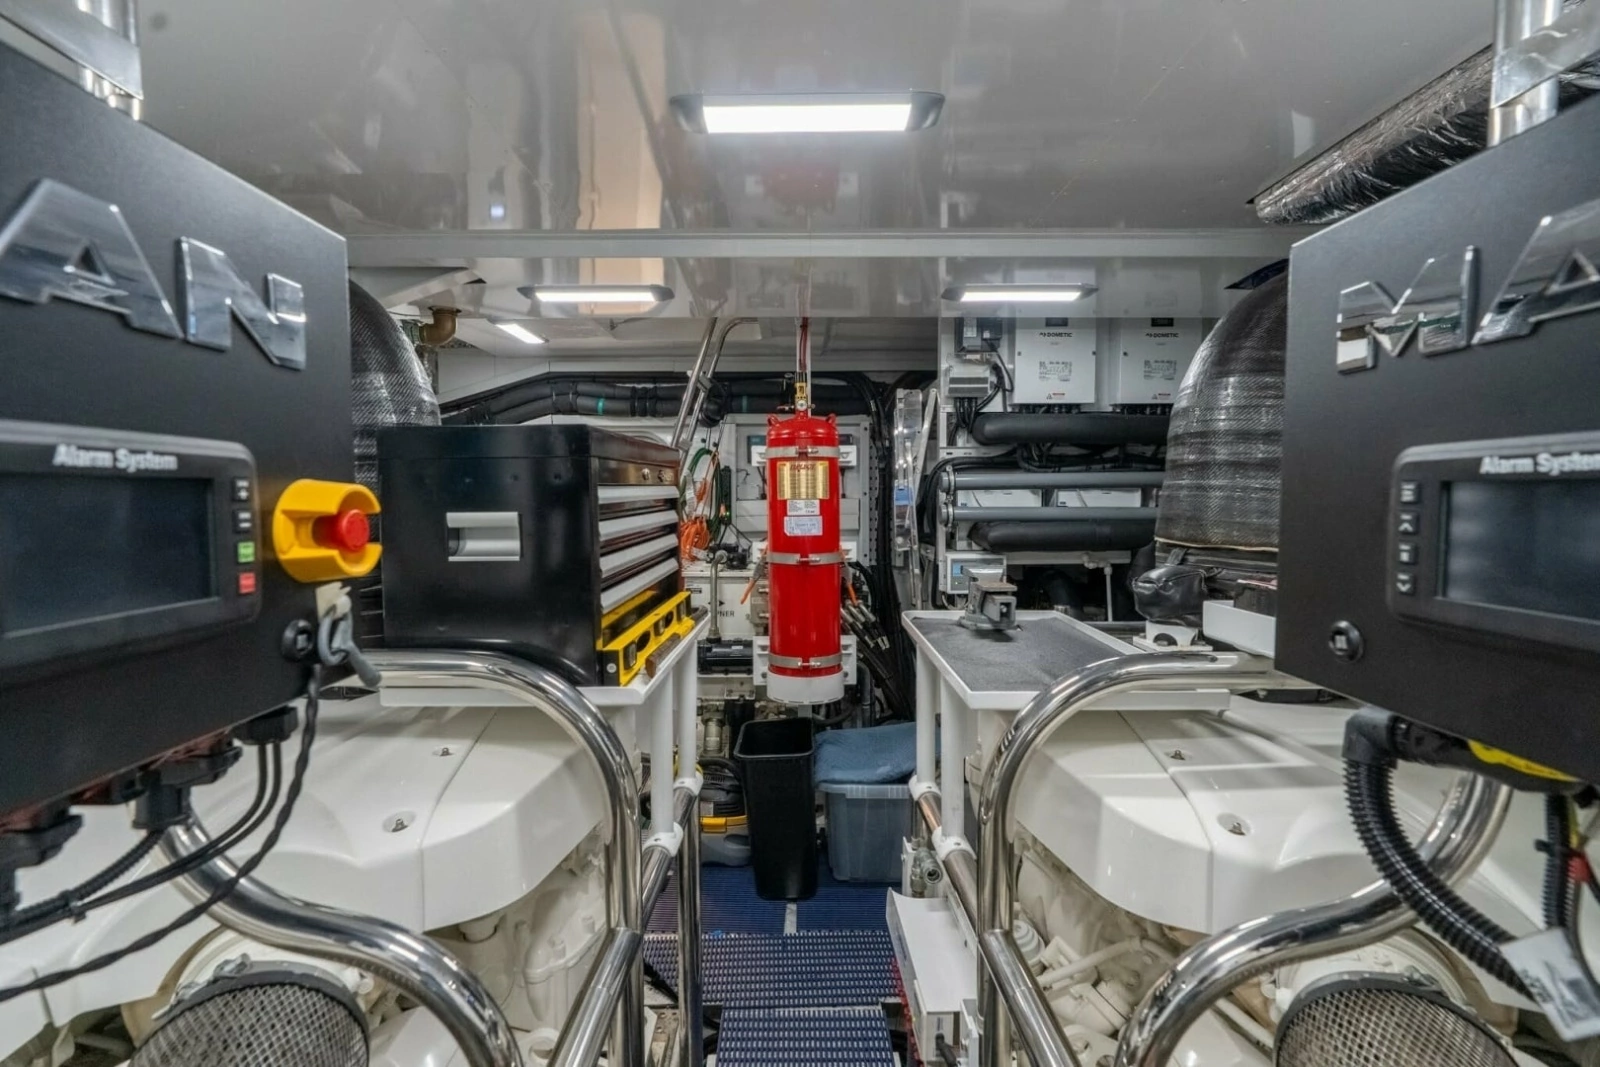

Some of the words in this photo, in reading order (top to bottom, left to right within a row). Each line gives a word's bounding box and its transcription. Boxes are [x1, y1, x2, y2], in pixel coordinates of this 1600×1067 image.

[53, 443, 113, 468] Alarm
[115, 447, 177, 473] System
[1480, 455, 1534, 474] Alarm
